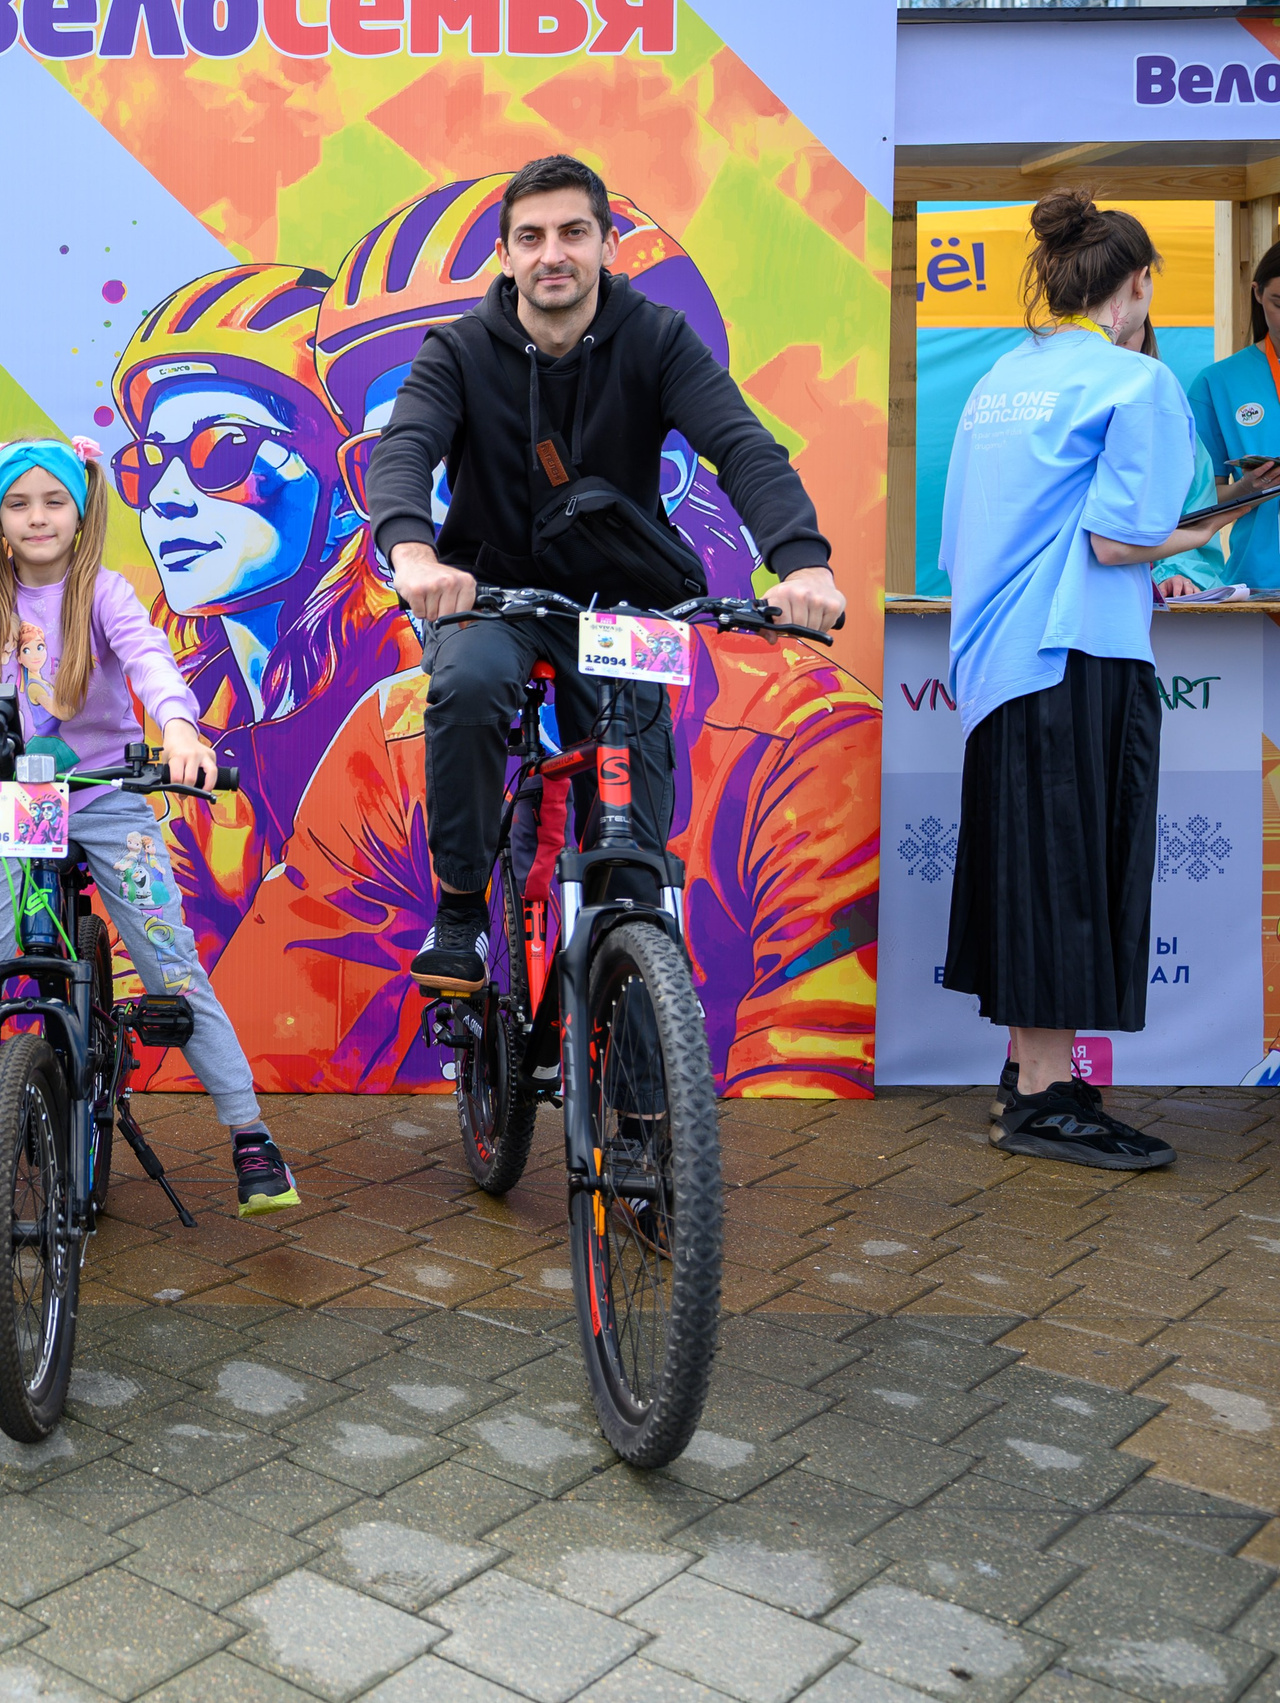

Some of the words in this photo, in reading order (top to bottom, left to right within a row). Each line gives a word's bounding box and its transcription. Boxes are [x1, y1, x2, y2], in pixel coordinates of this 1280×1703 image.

[964, 393, 1008, 417] MDIA
[1012, 391, 1060, 408] ONE
[585, 654, 627, 667] 12094
[600, 815, 631, 824] STEL
